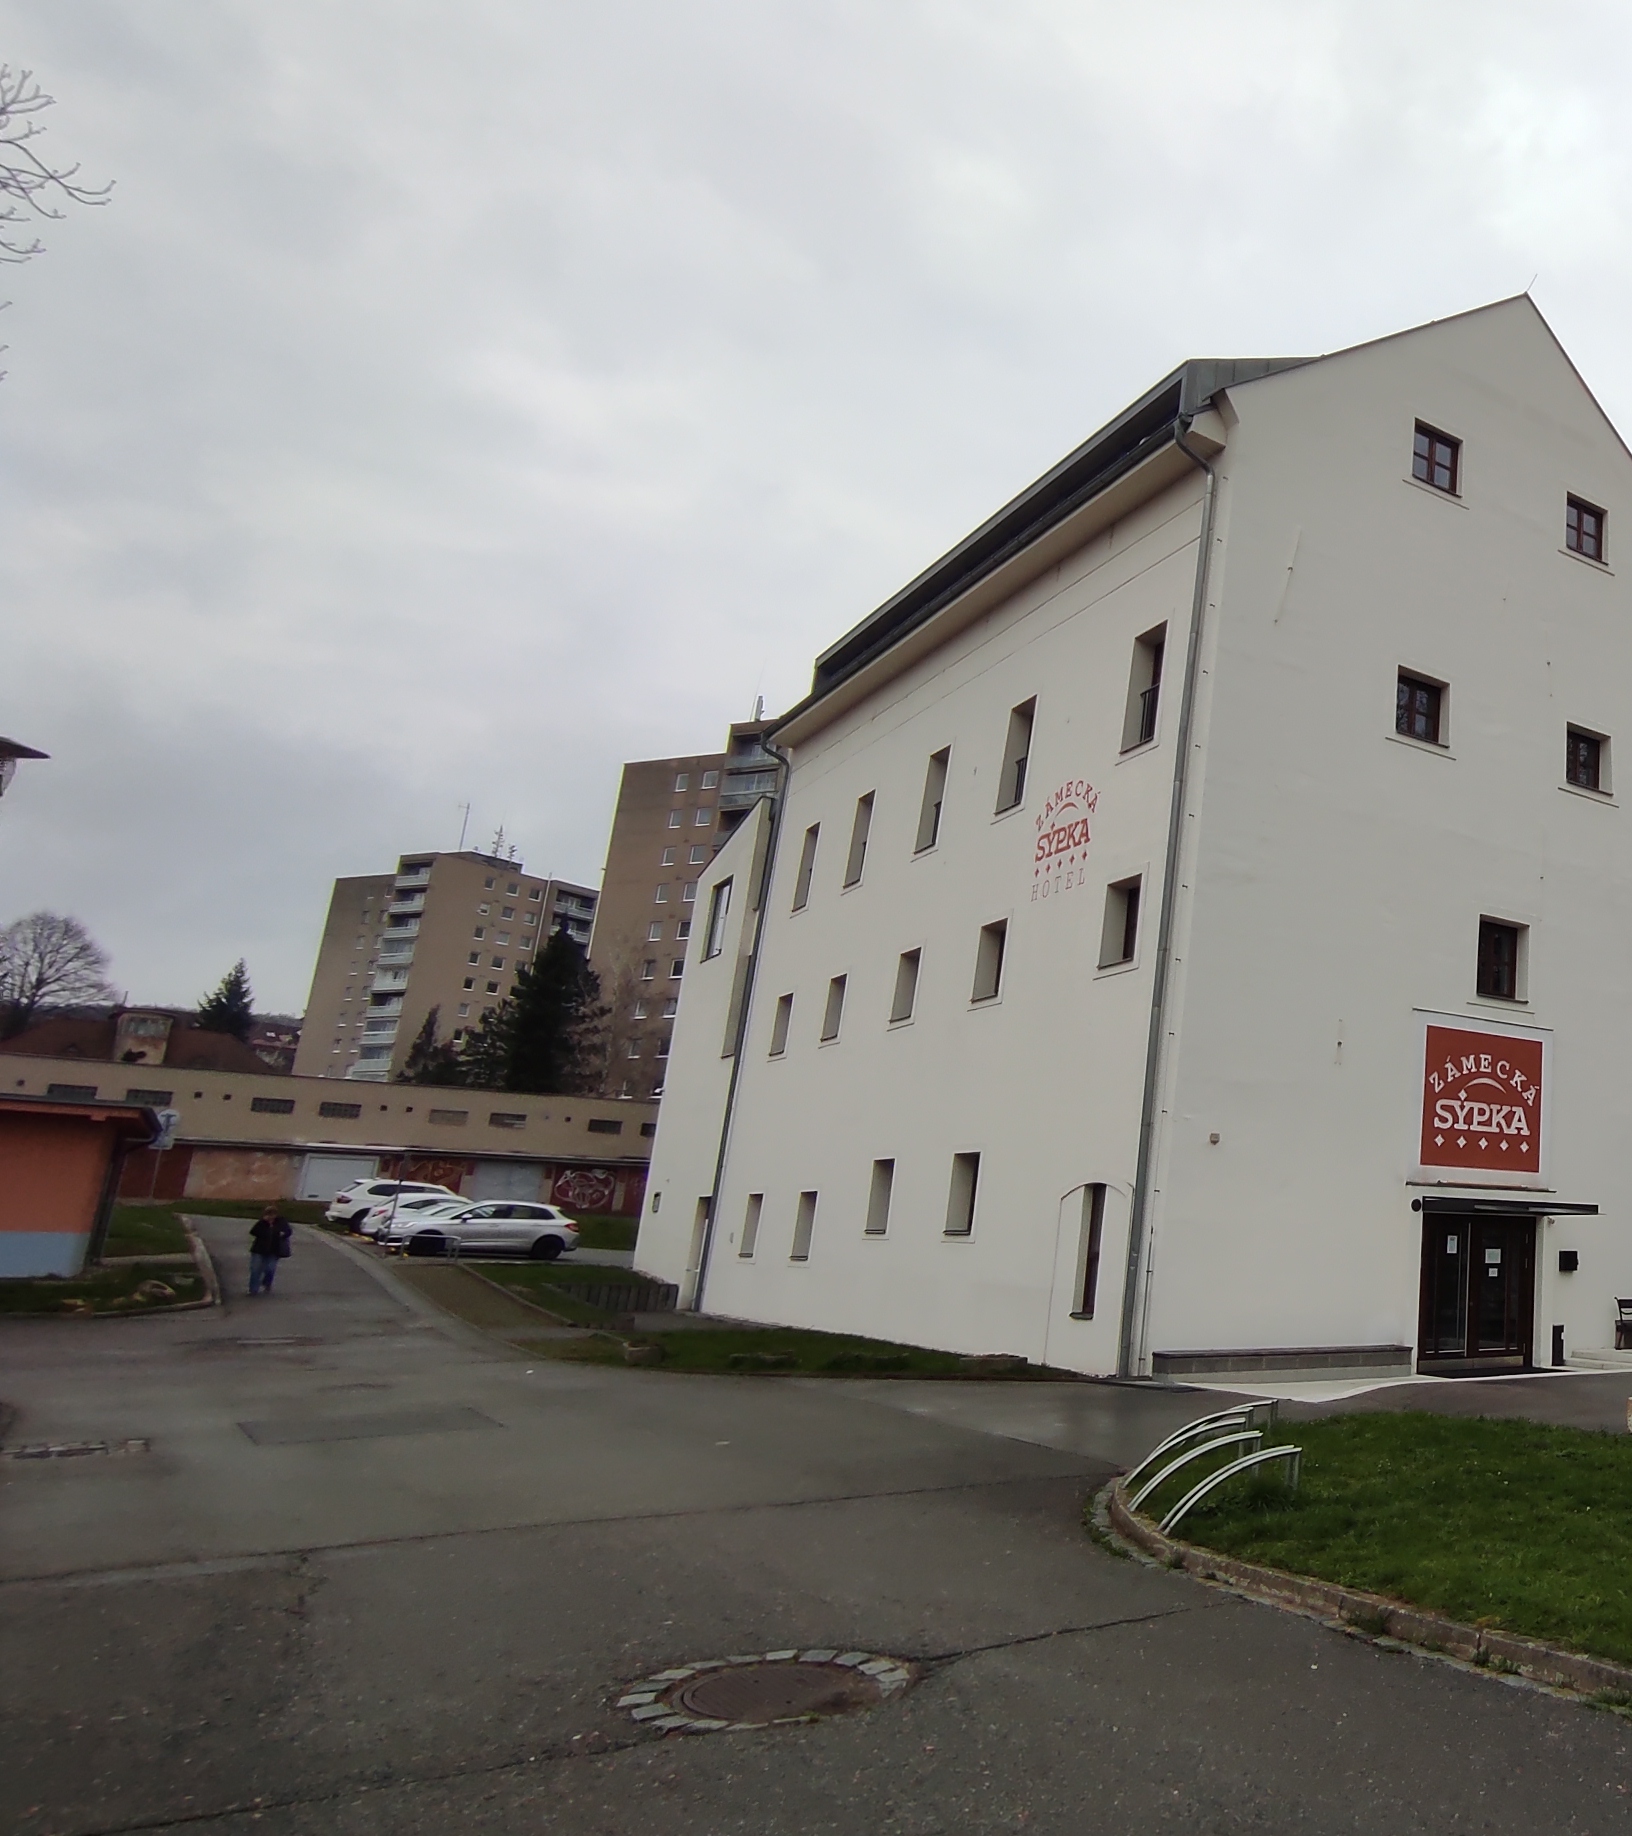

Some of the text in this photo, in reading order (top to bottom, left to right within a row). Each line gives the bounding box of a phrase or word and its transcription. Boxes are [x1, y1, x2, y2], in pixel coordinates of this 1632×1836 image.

[1035, 780, 1101, 831] ZÁMECKÁ
[1030, 867, 1086, 902] HOTEL
[1428, 1054, 1540, 1106] ZÁMECKÁ
